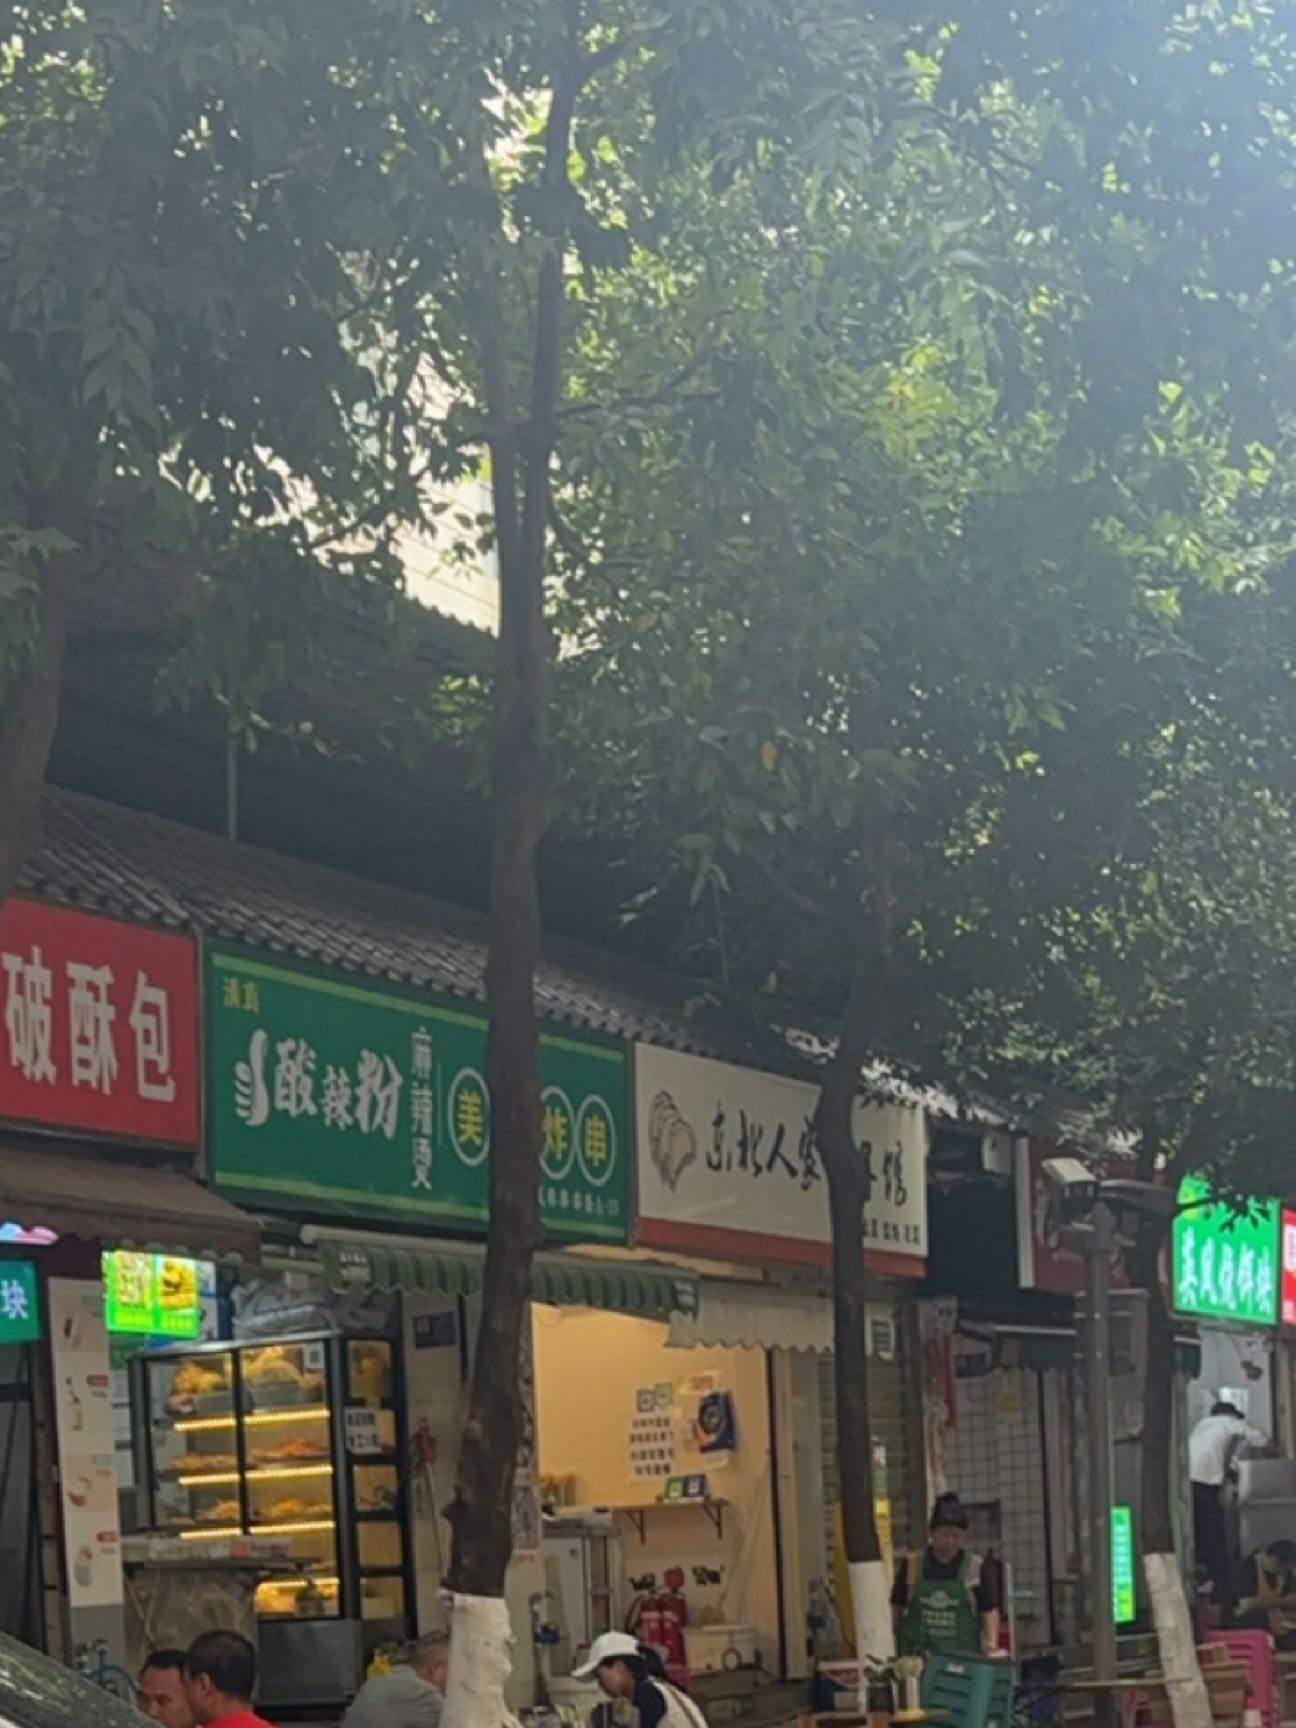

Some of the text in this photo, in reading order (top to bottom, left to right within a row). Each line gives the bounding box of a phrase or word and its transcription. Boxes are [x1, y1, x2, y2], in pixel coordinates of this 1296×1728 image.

[274, 1038, 403, 1140] 酸辣粉
[455, 1088, 608, 1168] 美炸串
